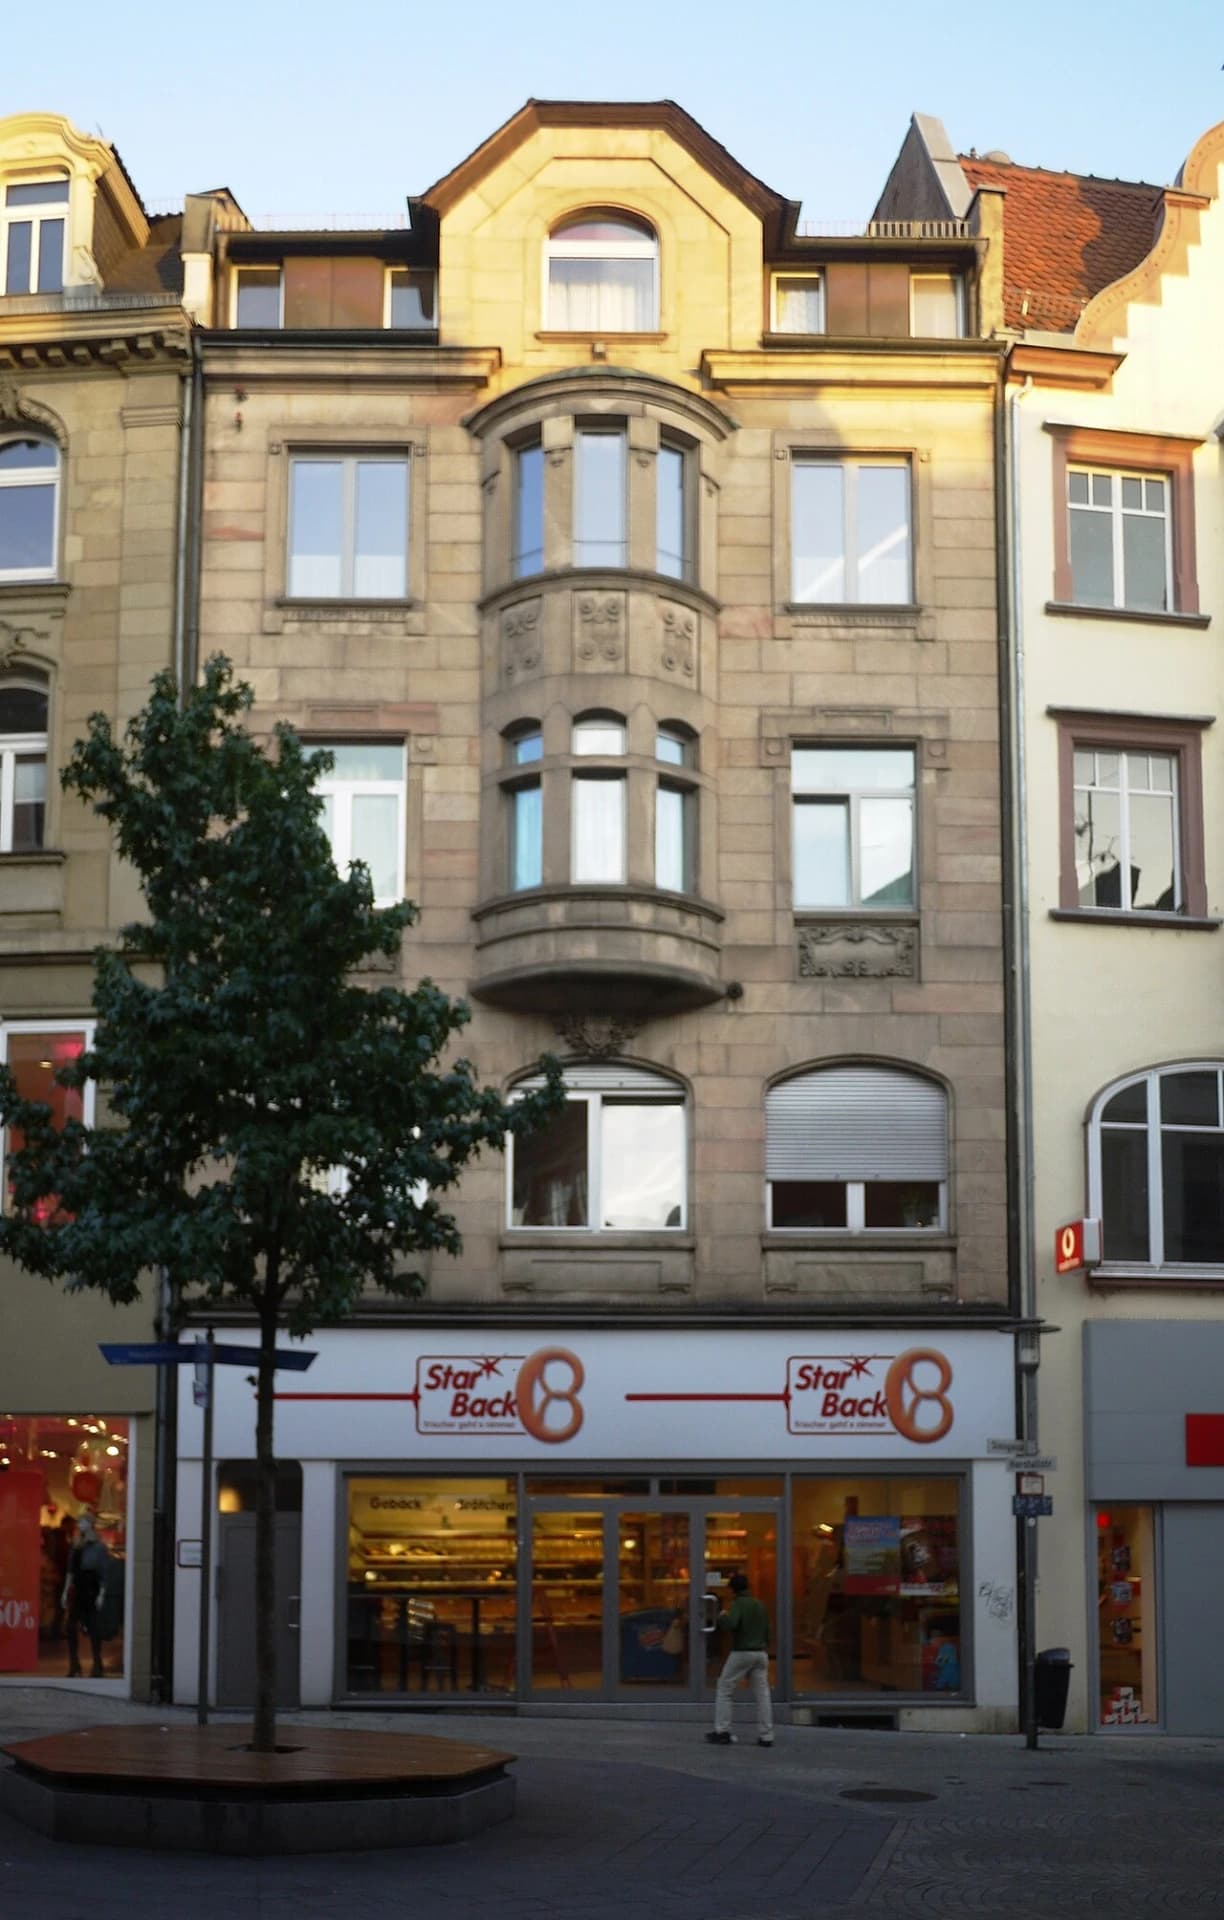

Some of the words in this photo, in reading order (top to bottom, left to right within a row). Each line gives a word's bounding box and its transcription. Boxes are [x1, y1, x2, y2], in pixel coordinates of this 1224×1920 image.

[424, 1364, 482, 1390] Star
[795, 1364, 852, 1390] Star
[450, 1390, 518, 1418] Back
[821, 1390, 888, 1418] Back
